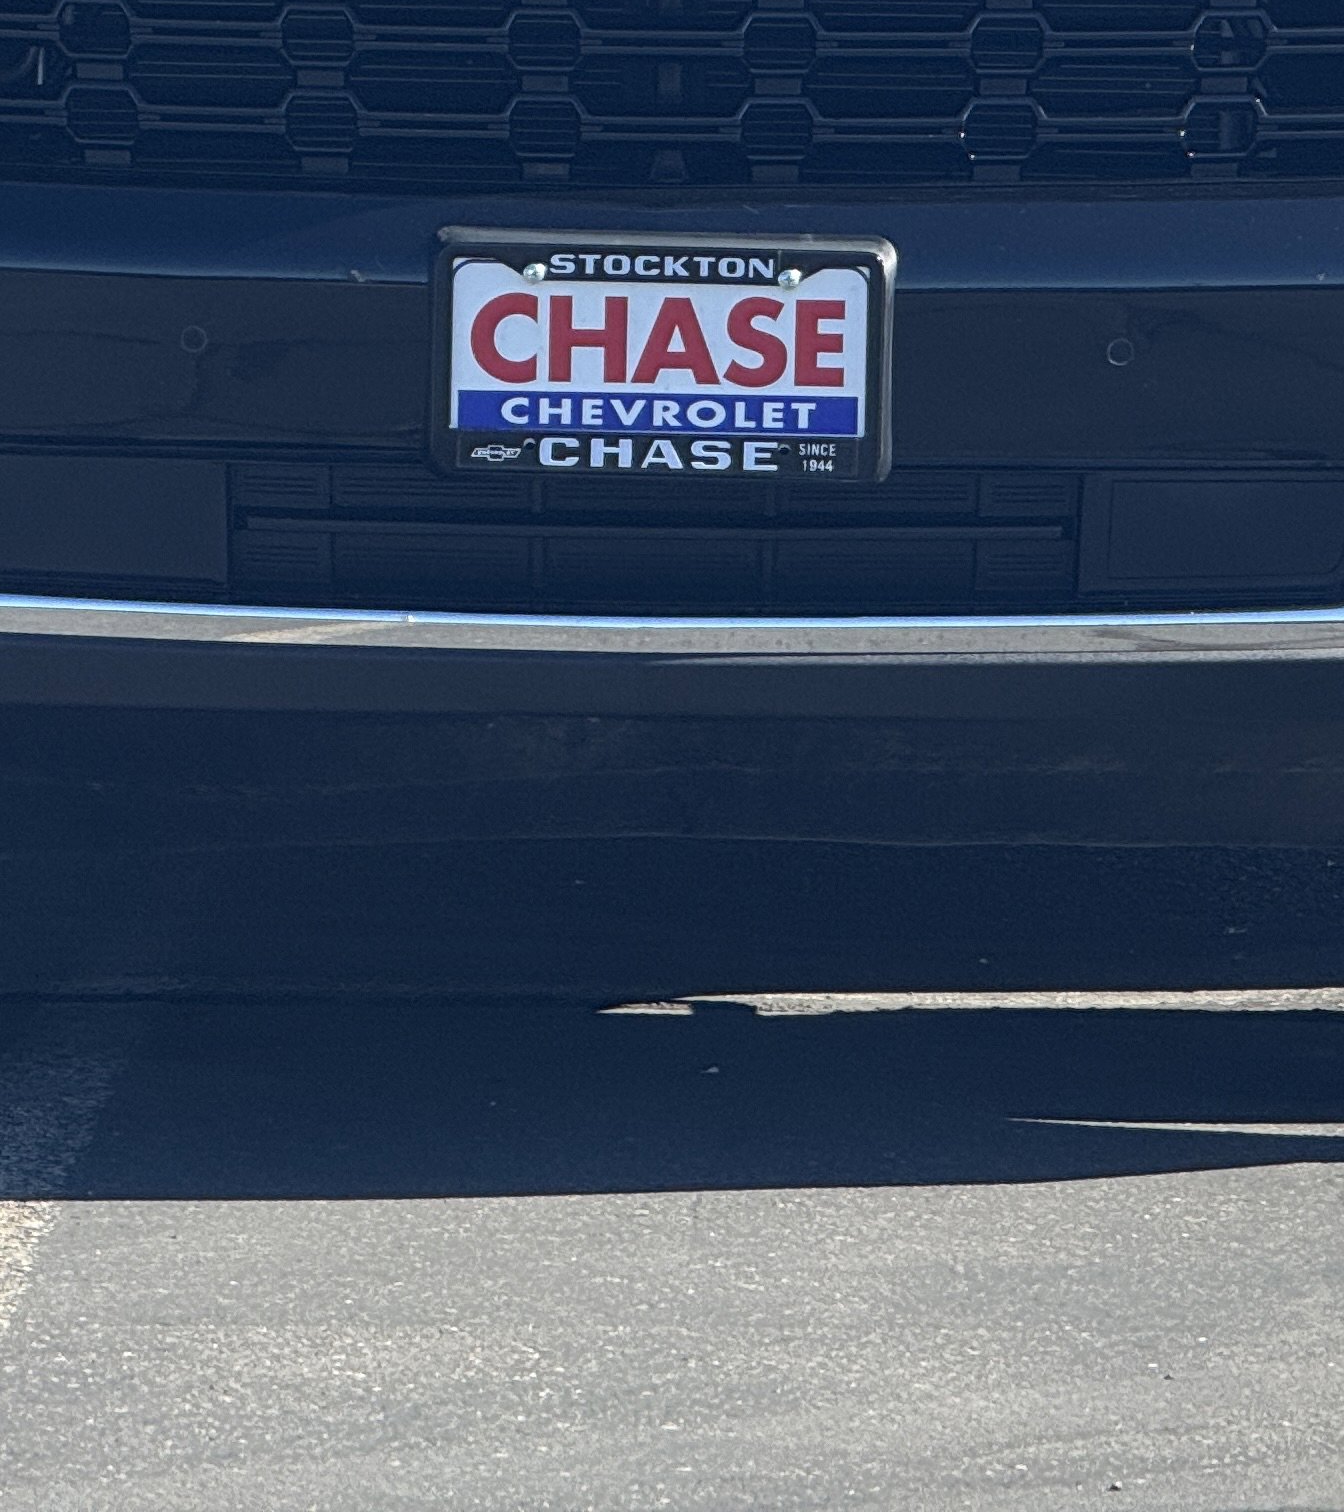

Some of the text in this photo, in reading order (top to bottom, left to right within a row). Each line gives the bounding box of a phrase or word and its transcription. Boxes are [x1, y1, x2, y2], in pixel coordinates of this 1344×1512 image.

[548, 253, 776, 280] STOCKTON
[470, 291, 847, 389] CHASE
[500, 397, 817, 430] CHEVROLET
[538, 437, 780, 473] CHASE
[798, 442, 837, 458] SINCE
[801, 459, 835, 473] 1944
